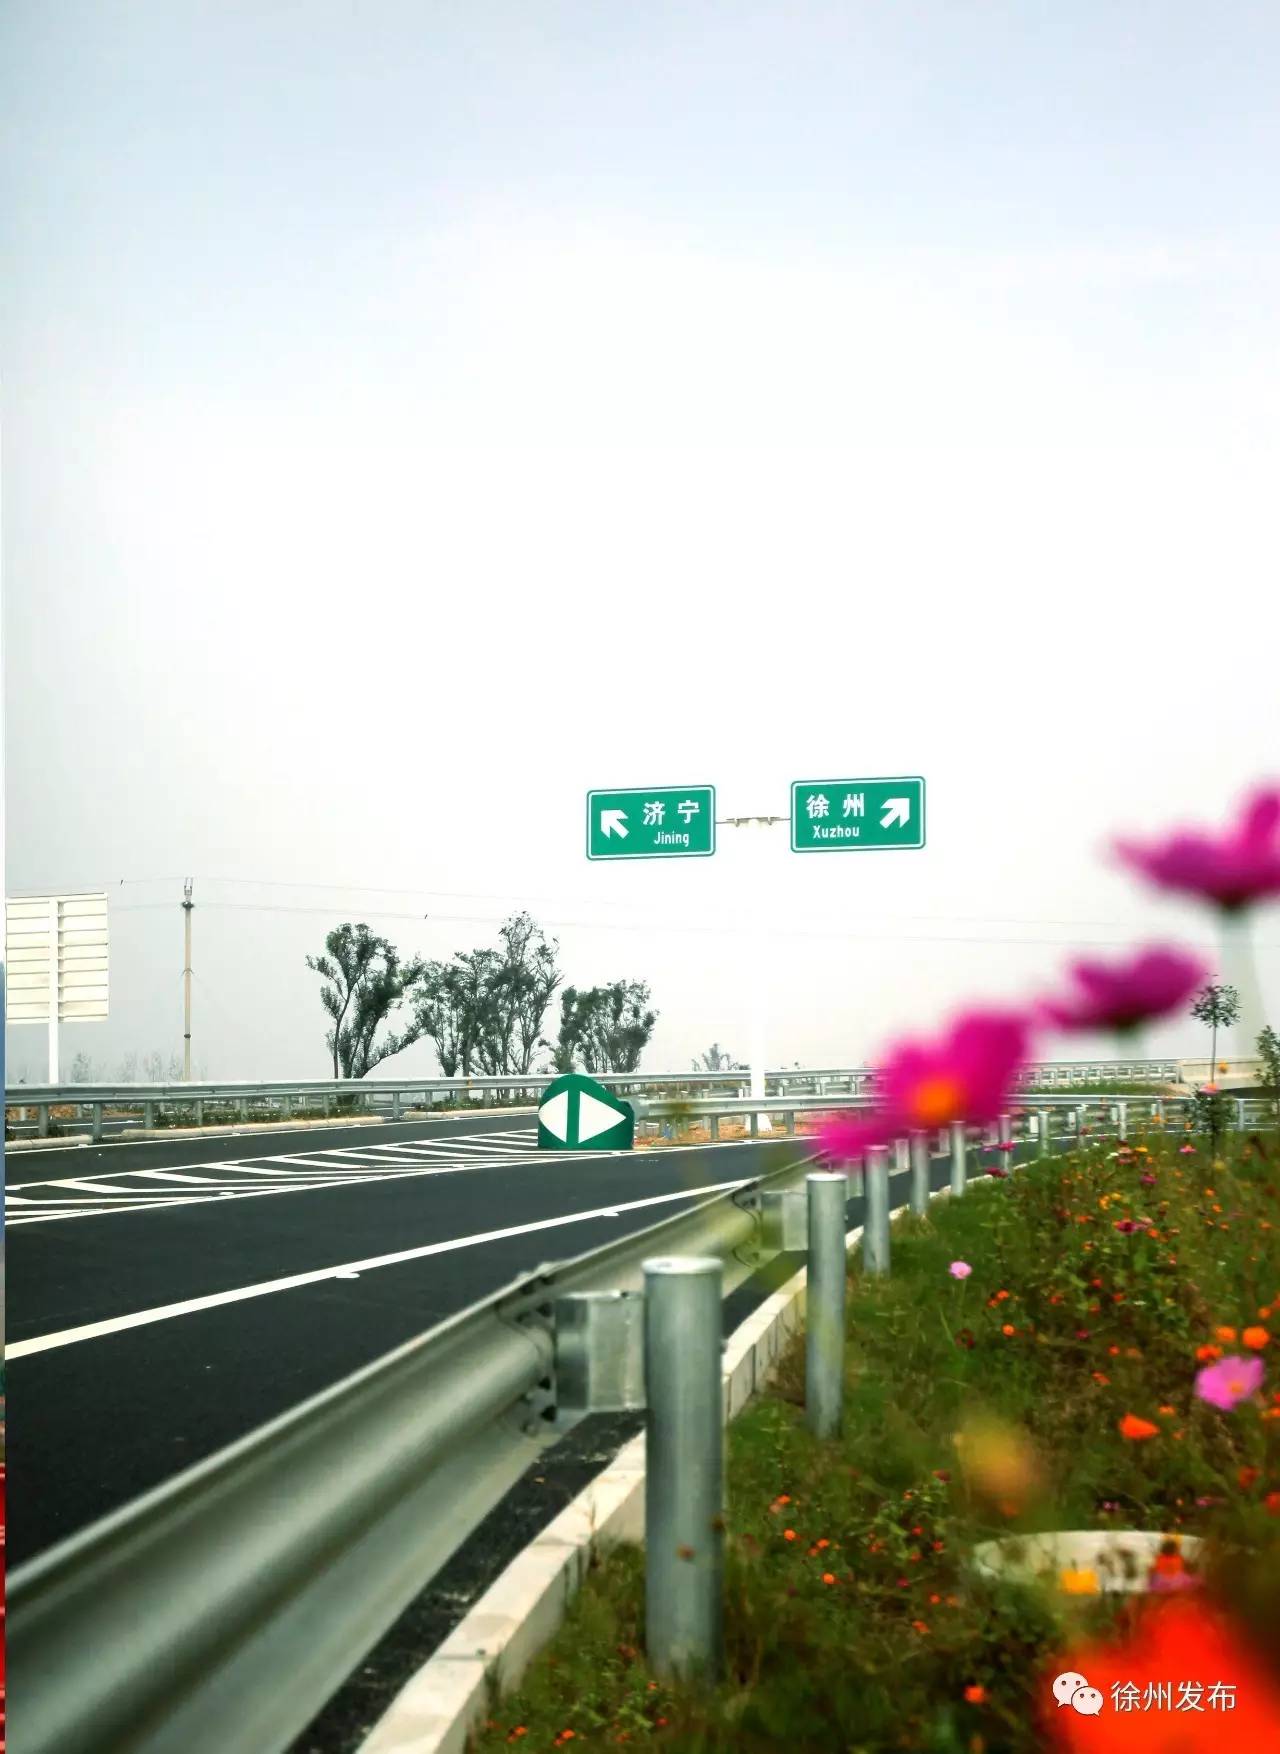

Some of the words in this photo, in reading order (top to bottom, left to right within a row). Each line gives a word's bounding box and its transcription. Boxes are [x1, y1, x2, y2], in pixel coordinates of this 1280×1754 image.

[642, 799, 700, 826] 济宁
[806, 792, 865, 819] 徐州
[653, 830, 690, 848] Jining
[812, 824, 860, 839] Xuzhou
